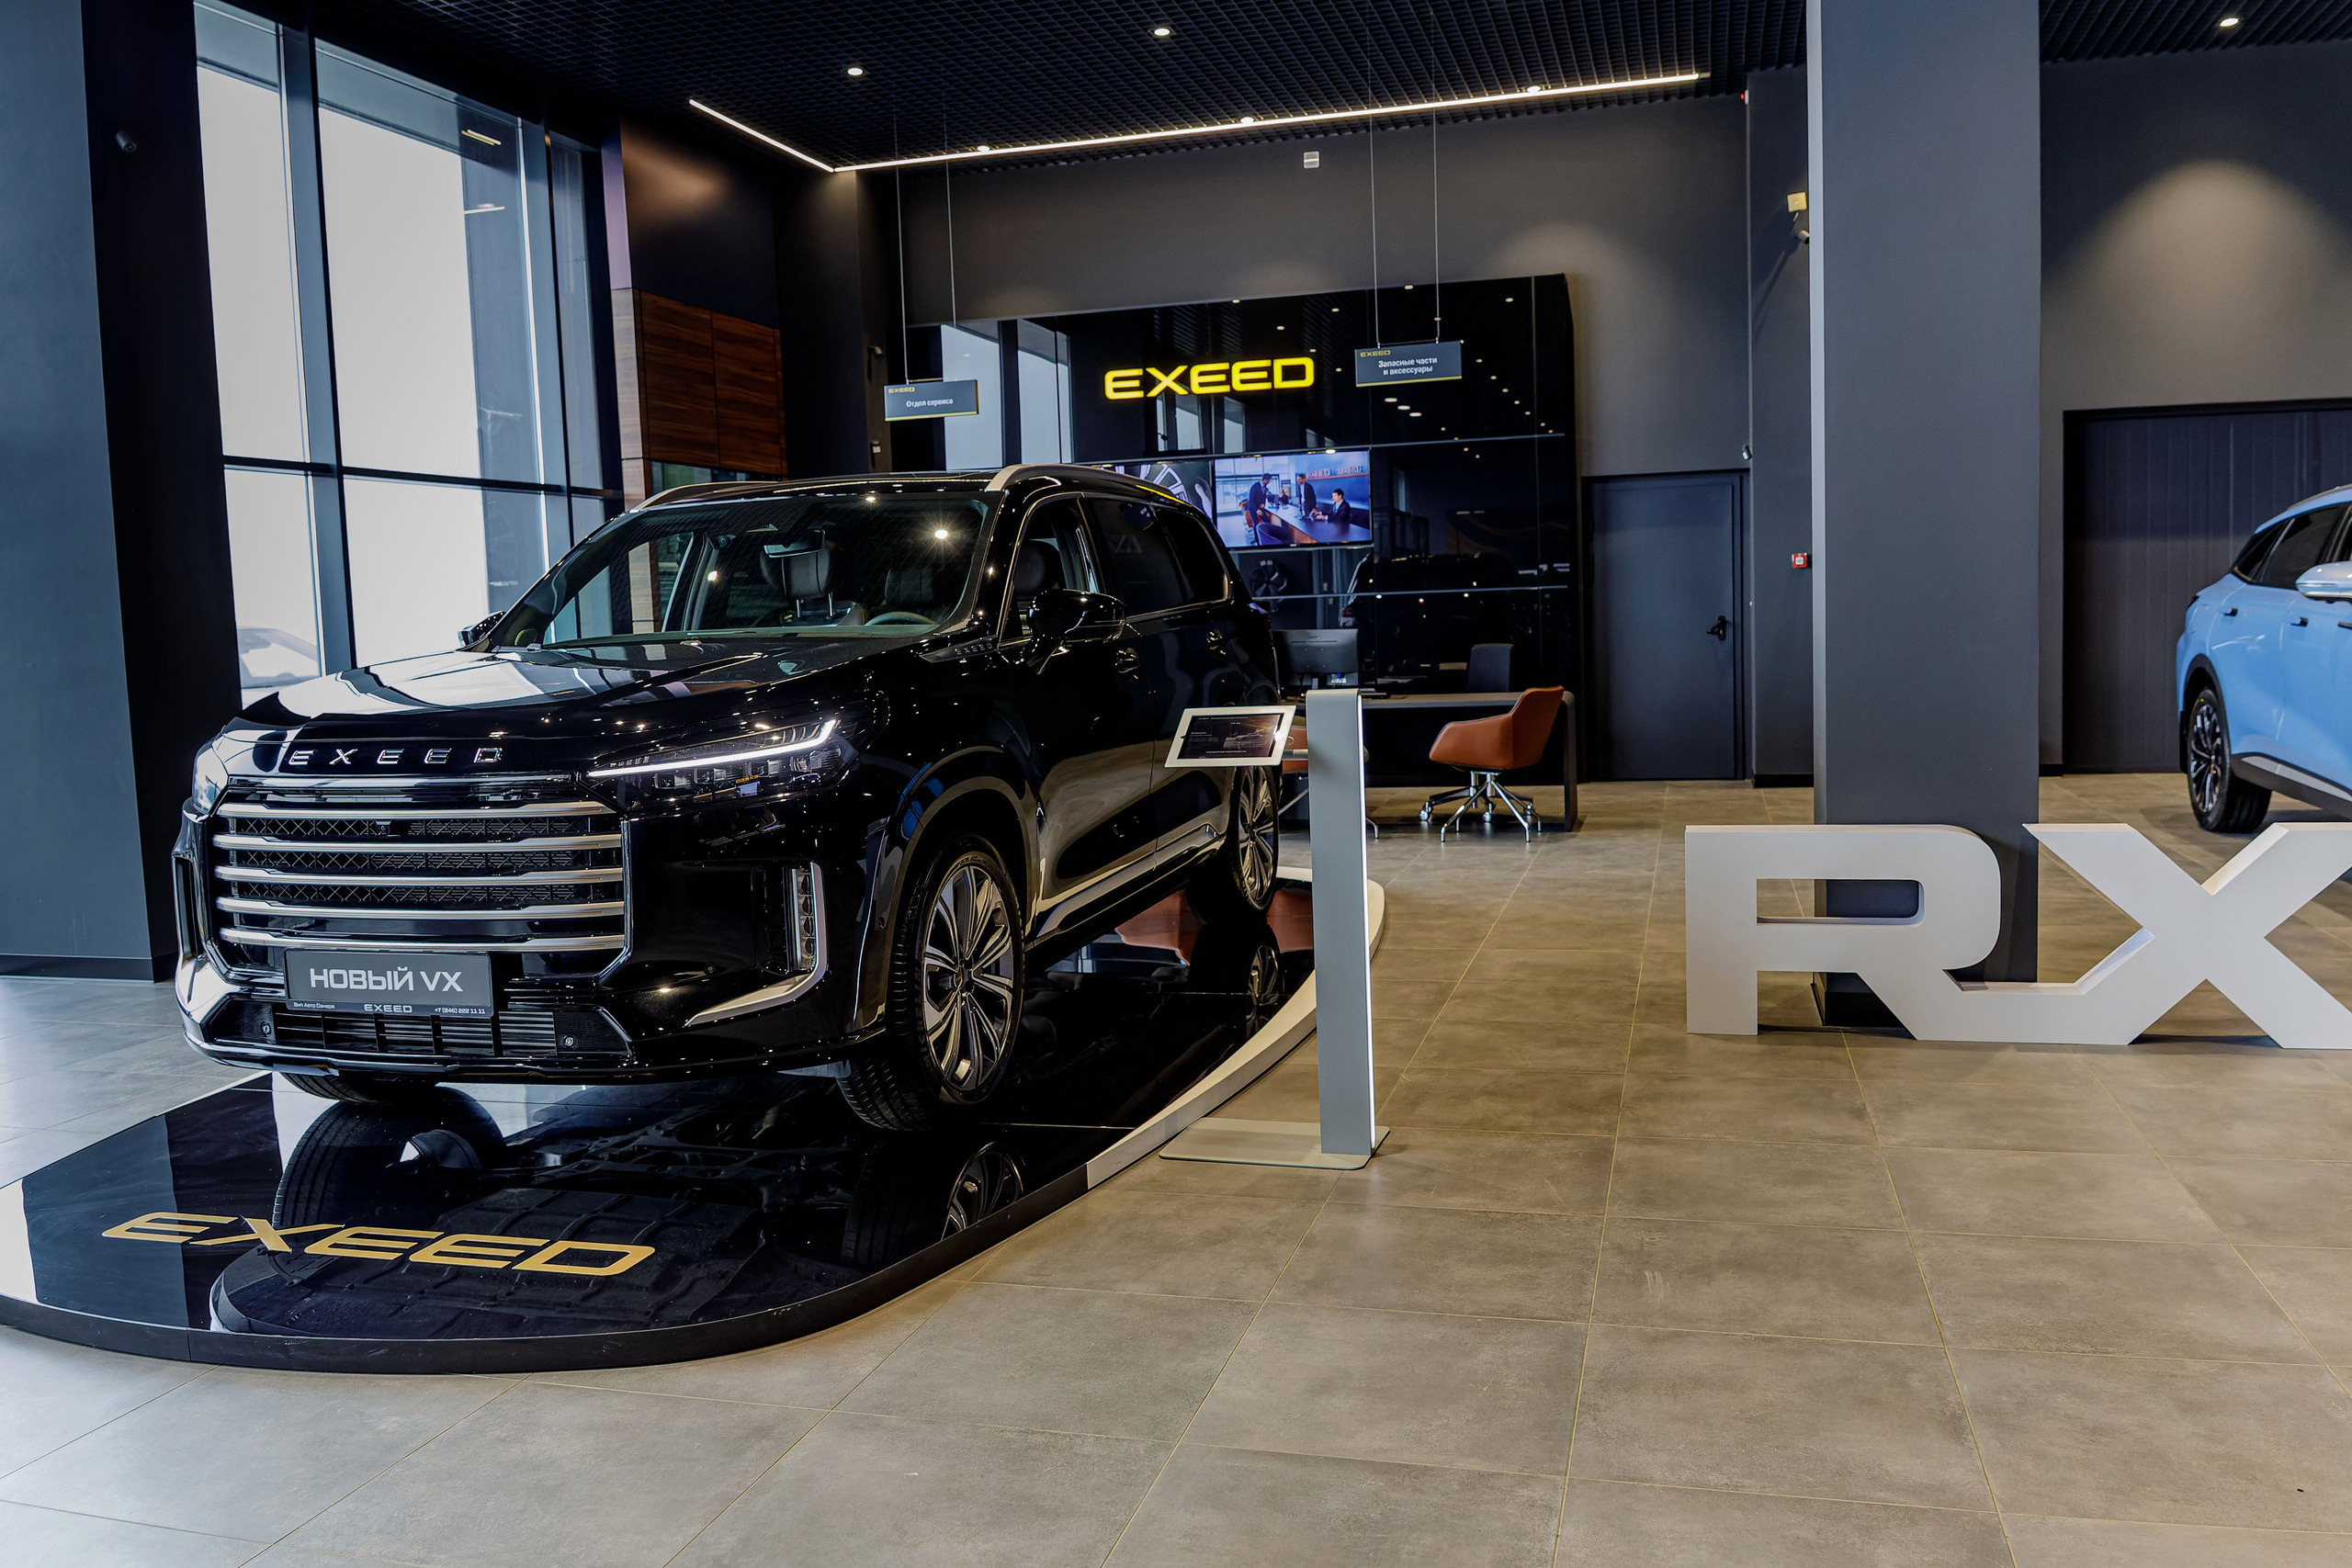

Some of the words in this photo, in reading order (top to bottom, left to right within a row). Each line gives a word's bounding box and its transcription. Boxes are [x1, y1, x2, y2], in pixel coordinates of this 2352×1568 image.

[1378, 359, 1415, 368] Запасные
[1389, 366, 1433, 375] аксессуары
[1103, 356, 1315, 400] EXEED
[906, 400, 927, 408] Отдел
[927, 398, 954, 407] сервиса
[956, 643, 993, 655] EXEED
[288, 748, 503, 766] EXEED
[1685, 822, 2352, 1050] RX
[310, 966, 413, 991] НОВЫЙ
[419, 971, 463, 992] VX
[364, 1003, 413, 1013] EXEED
[101, 1211, 656, 1276] EXEED
